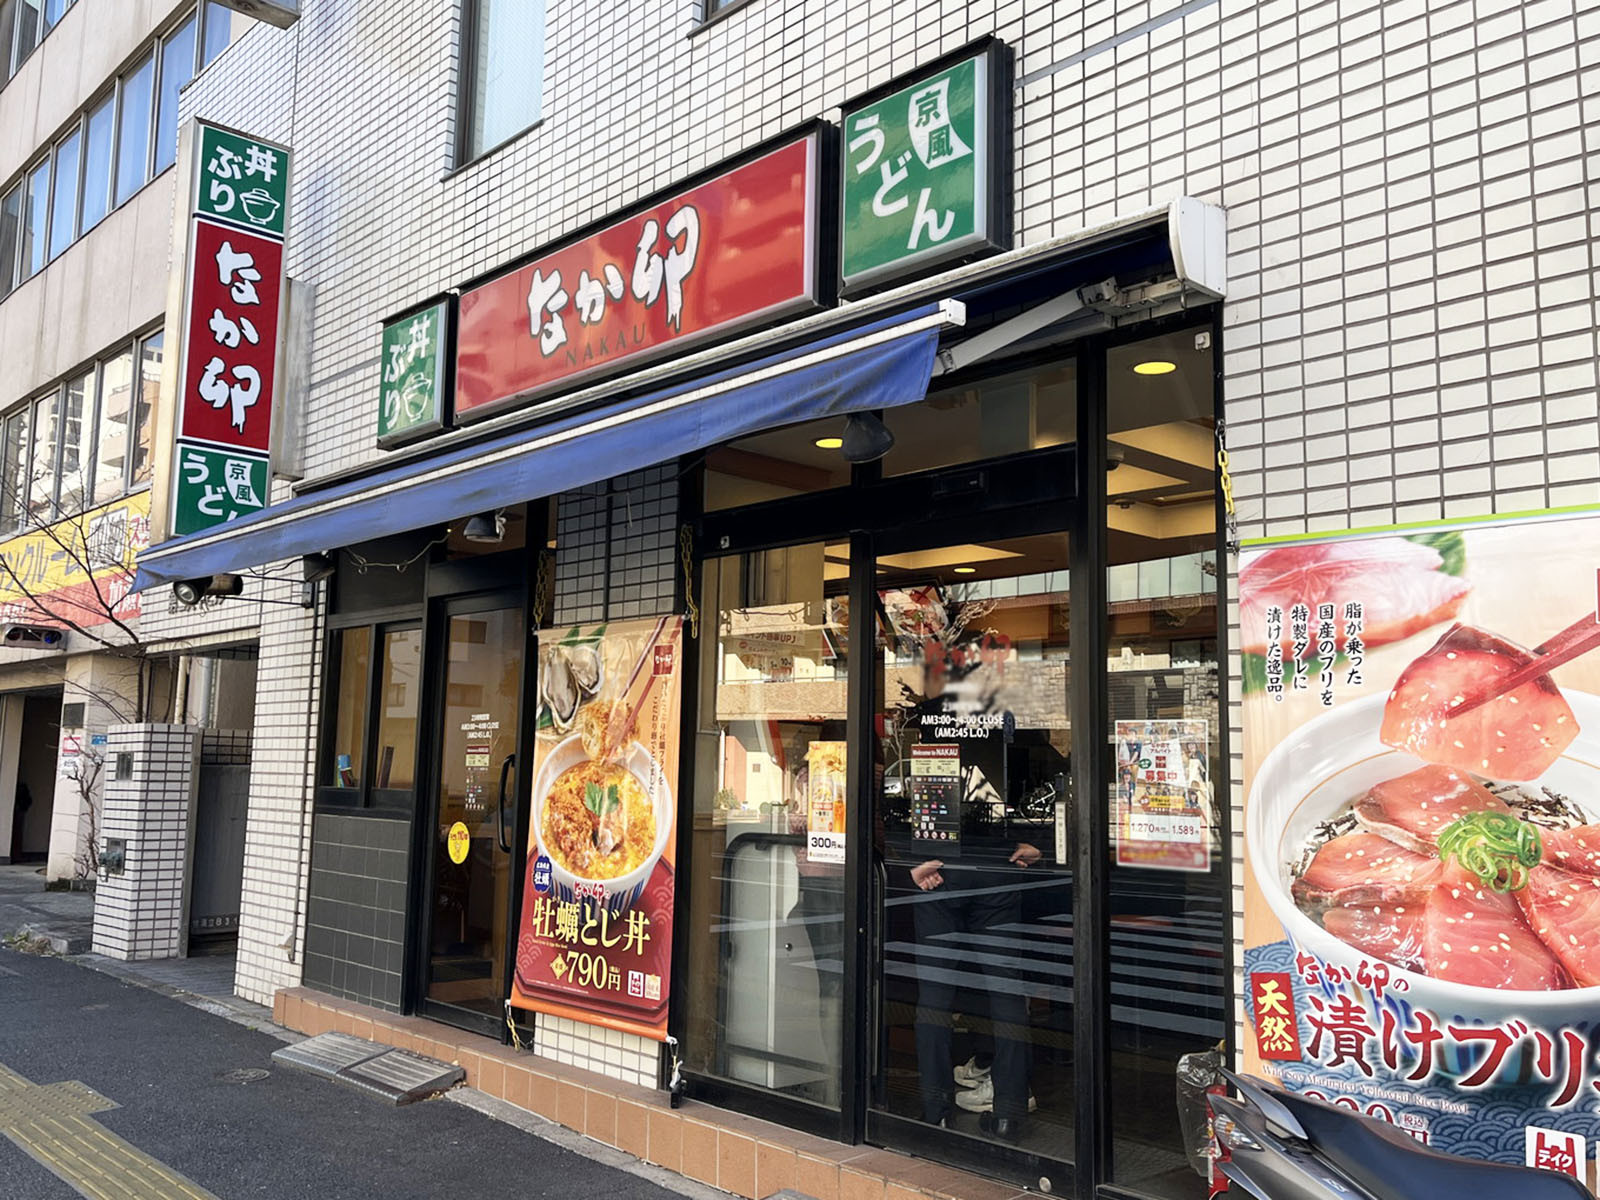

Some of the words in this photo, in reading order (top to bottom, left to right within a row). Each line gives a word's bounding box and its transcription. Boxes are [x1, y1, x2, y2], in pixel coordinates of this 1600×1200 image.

[915, 88, 954, 163] 京風
[849, 112, 955, 249] うどん
[527, 205, 700, 357] なか卯
[198, 241, 262, 434] なか卯
[566, 323, 646, 366] NAKAU
[229, 463, 252, 502] 京風
[0, 527, 82, 592] ンクルーム
[1266, 607, 1284, 703] 漬けた逸品。
[1291, 605, 1309, 690] 特製ダレに
[1317, 604, 1335, 707] 国産のブリを
[1344, 602, 1363, 686] 脂が乗った
[935, 727, 968, 738] (AM2:45
[970, 727, 989, 739] L.O.)
[936, 748, 958, 756] NAKAU
[978, 714, 1004, 725] CLOSE
[532, 897, 651, 956] 牡蠣とじ丼
[1296, 951, 1409, 998] なか卯の
[1256, 980, 1293, 1053] 天然
[1305, 994, 1600, 1108] 漬けブリ
[1415, 1094, 1438, 1108] Rice
[1441, 1100, 1469, 1114] Bowl
[1538, 1149, 1573, 1168] テイク
